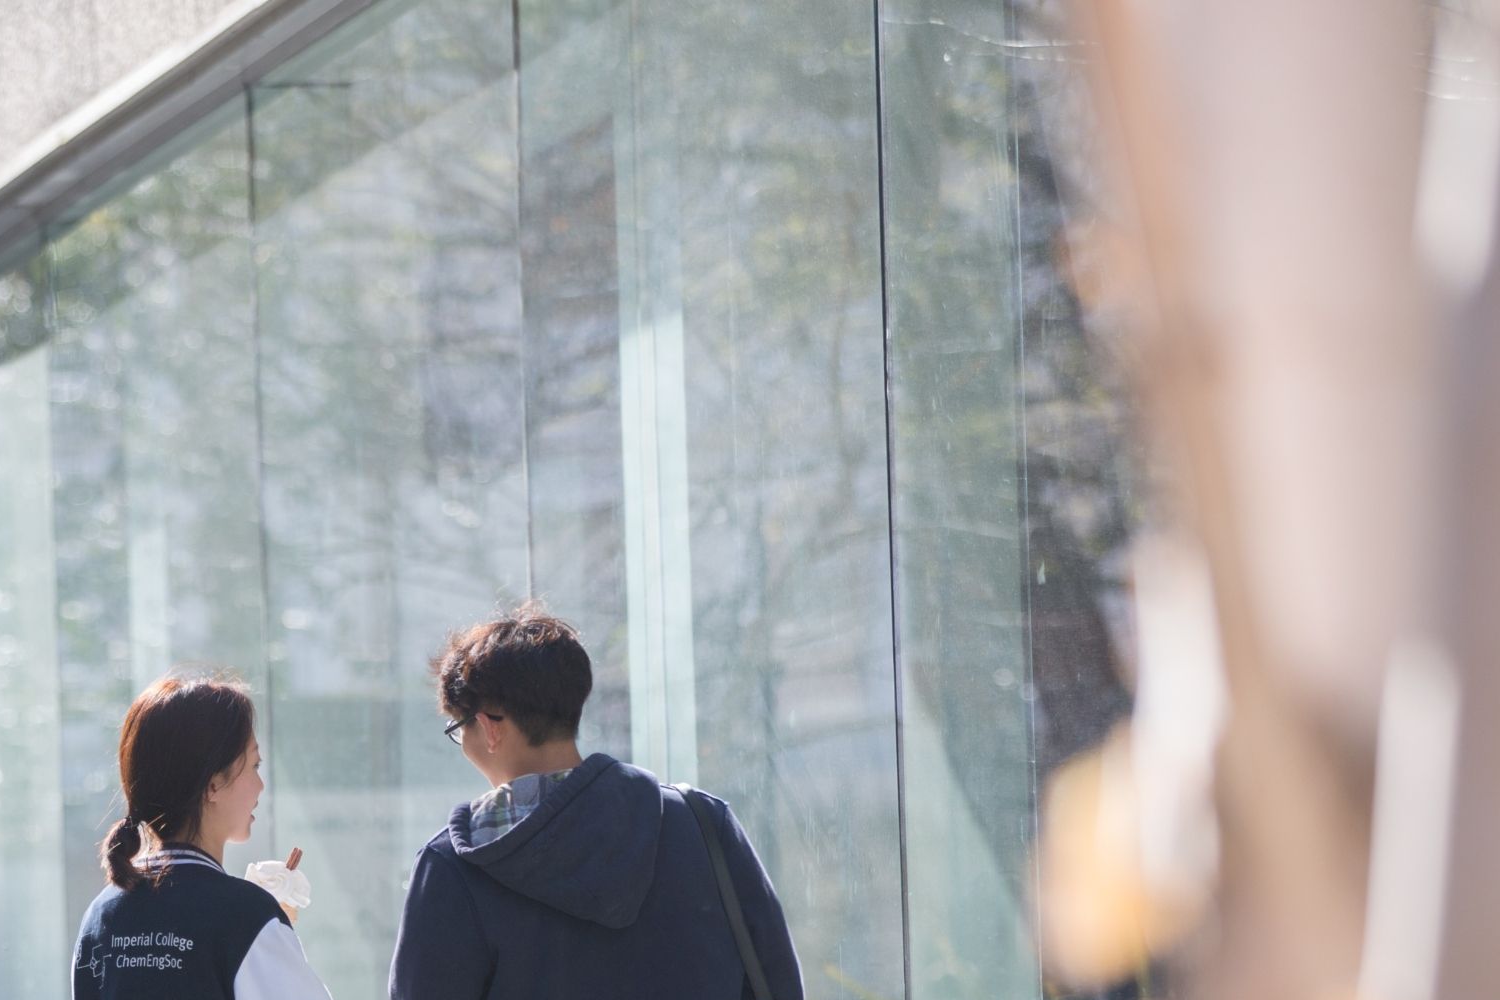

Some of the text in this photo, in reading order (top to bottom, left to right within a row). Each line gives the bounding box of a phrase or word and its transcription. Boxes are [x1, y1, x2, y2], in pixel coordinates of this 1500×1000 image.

[111, 932, 194, 951] Imperial College
[116, 953, 183, 970] ChemEngSoc
